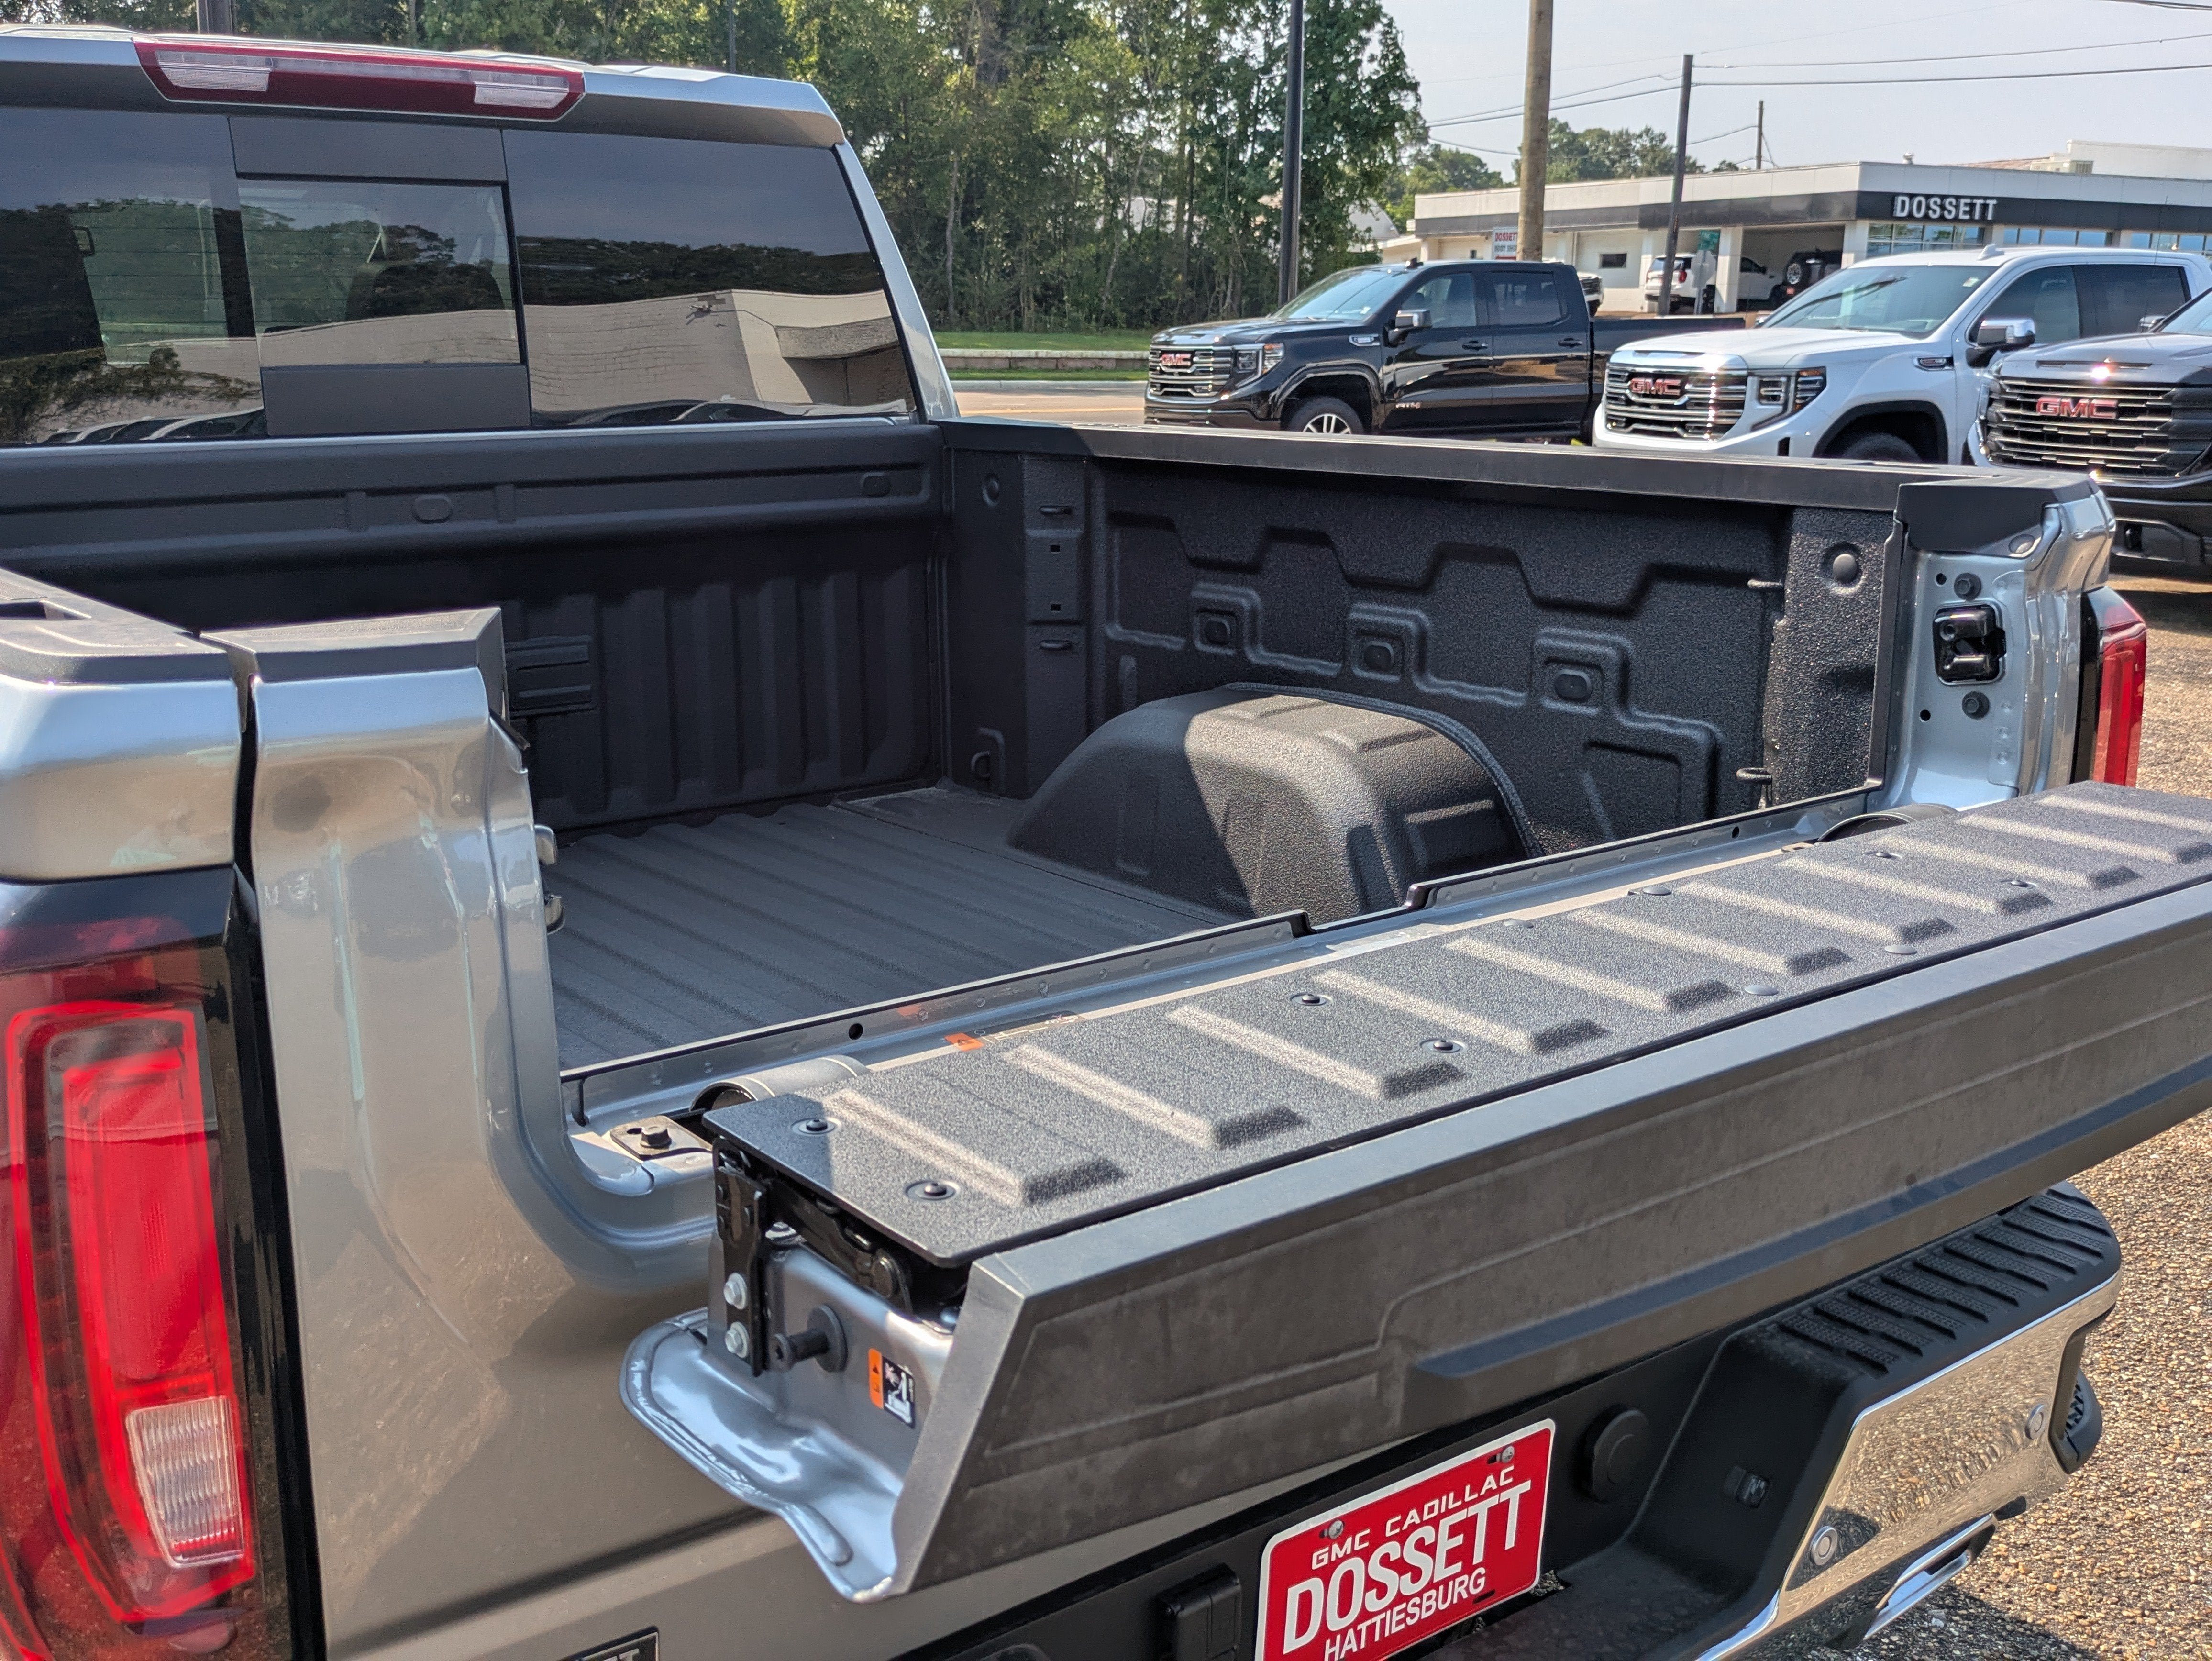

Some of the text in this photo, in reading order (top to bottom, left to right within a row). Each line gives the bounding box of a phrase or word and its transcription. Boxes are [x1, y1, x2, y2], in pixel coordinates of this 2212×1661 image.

[1893, 195, 1997, 220] DOSSETT
[1161, 354, 1191, 366] GMC
[1630, 378, 1681, 396] GMC
[2036, 397, 2118, 420] GMC
[1311, 1465, 1515, 1570] GMC CADILLAC
[1283, 1479, 1531, 1655] DOSSETT
[1324, 1567, 1486, 1661] HATTIESBURG
